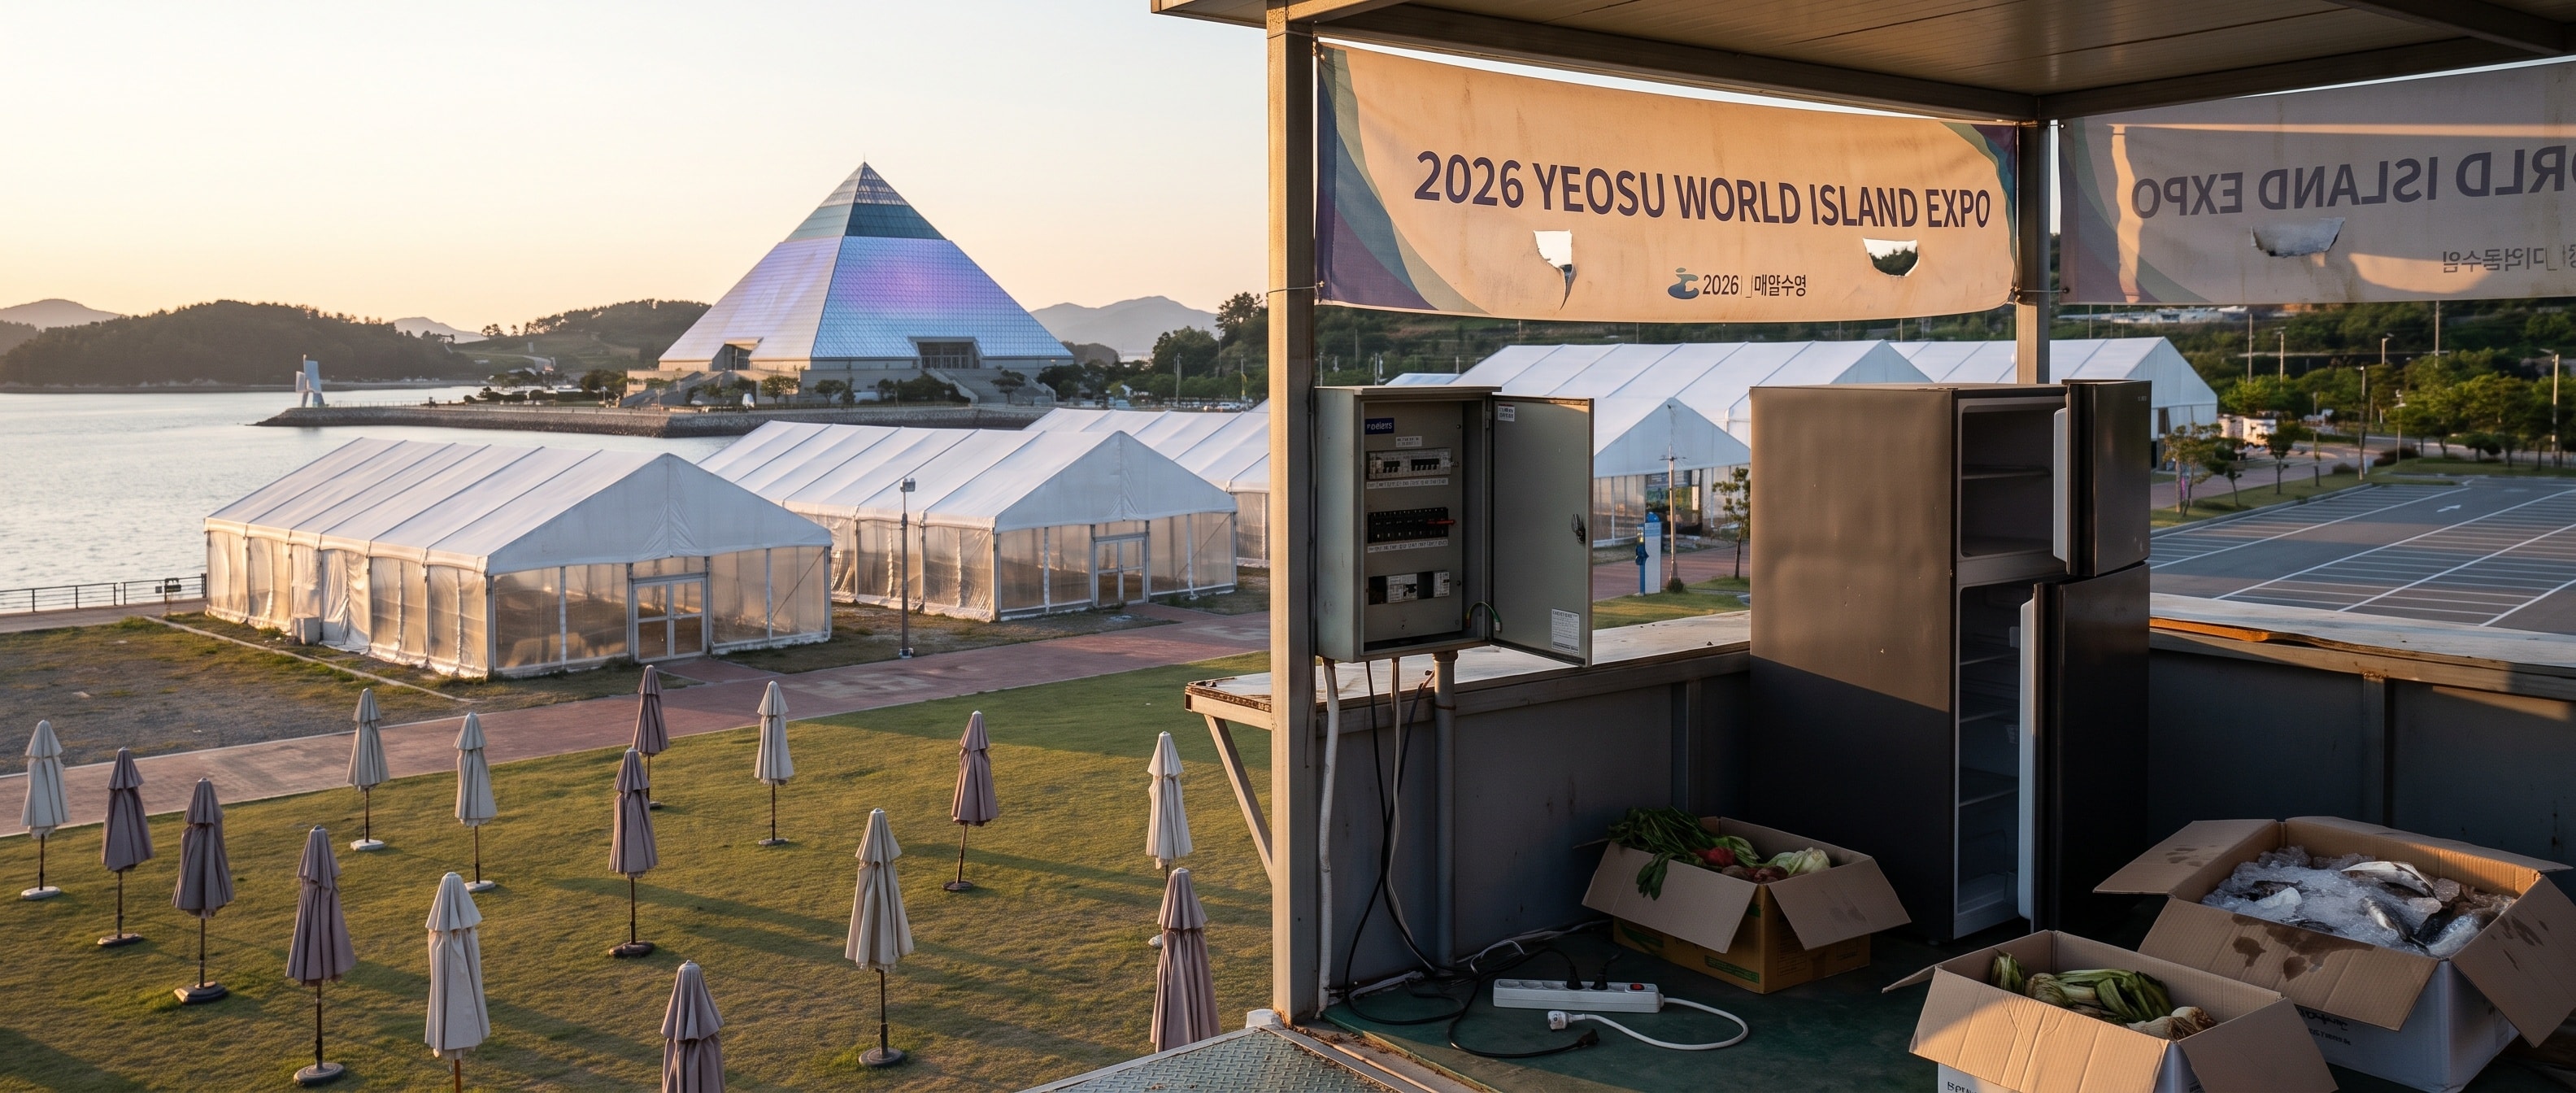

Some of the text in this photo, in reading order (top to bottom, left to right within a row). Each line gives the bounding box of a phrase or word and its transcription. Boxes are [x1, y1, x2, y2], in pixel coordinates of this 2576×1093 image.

[1414, 150, 1991, 229] 2026 YEOSU WORLD ISLAND EXPO
[1703, 274, 1739, 295] 2026
